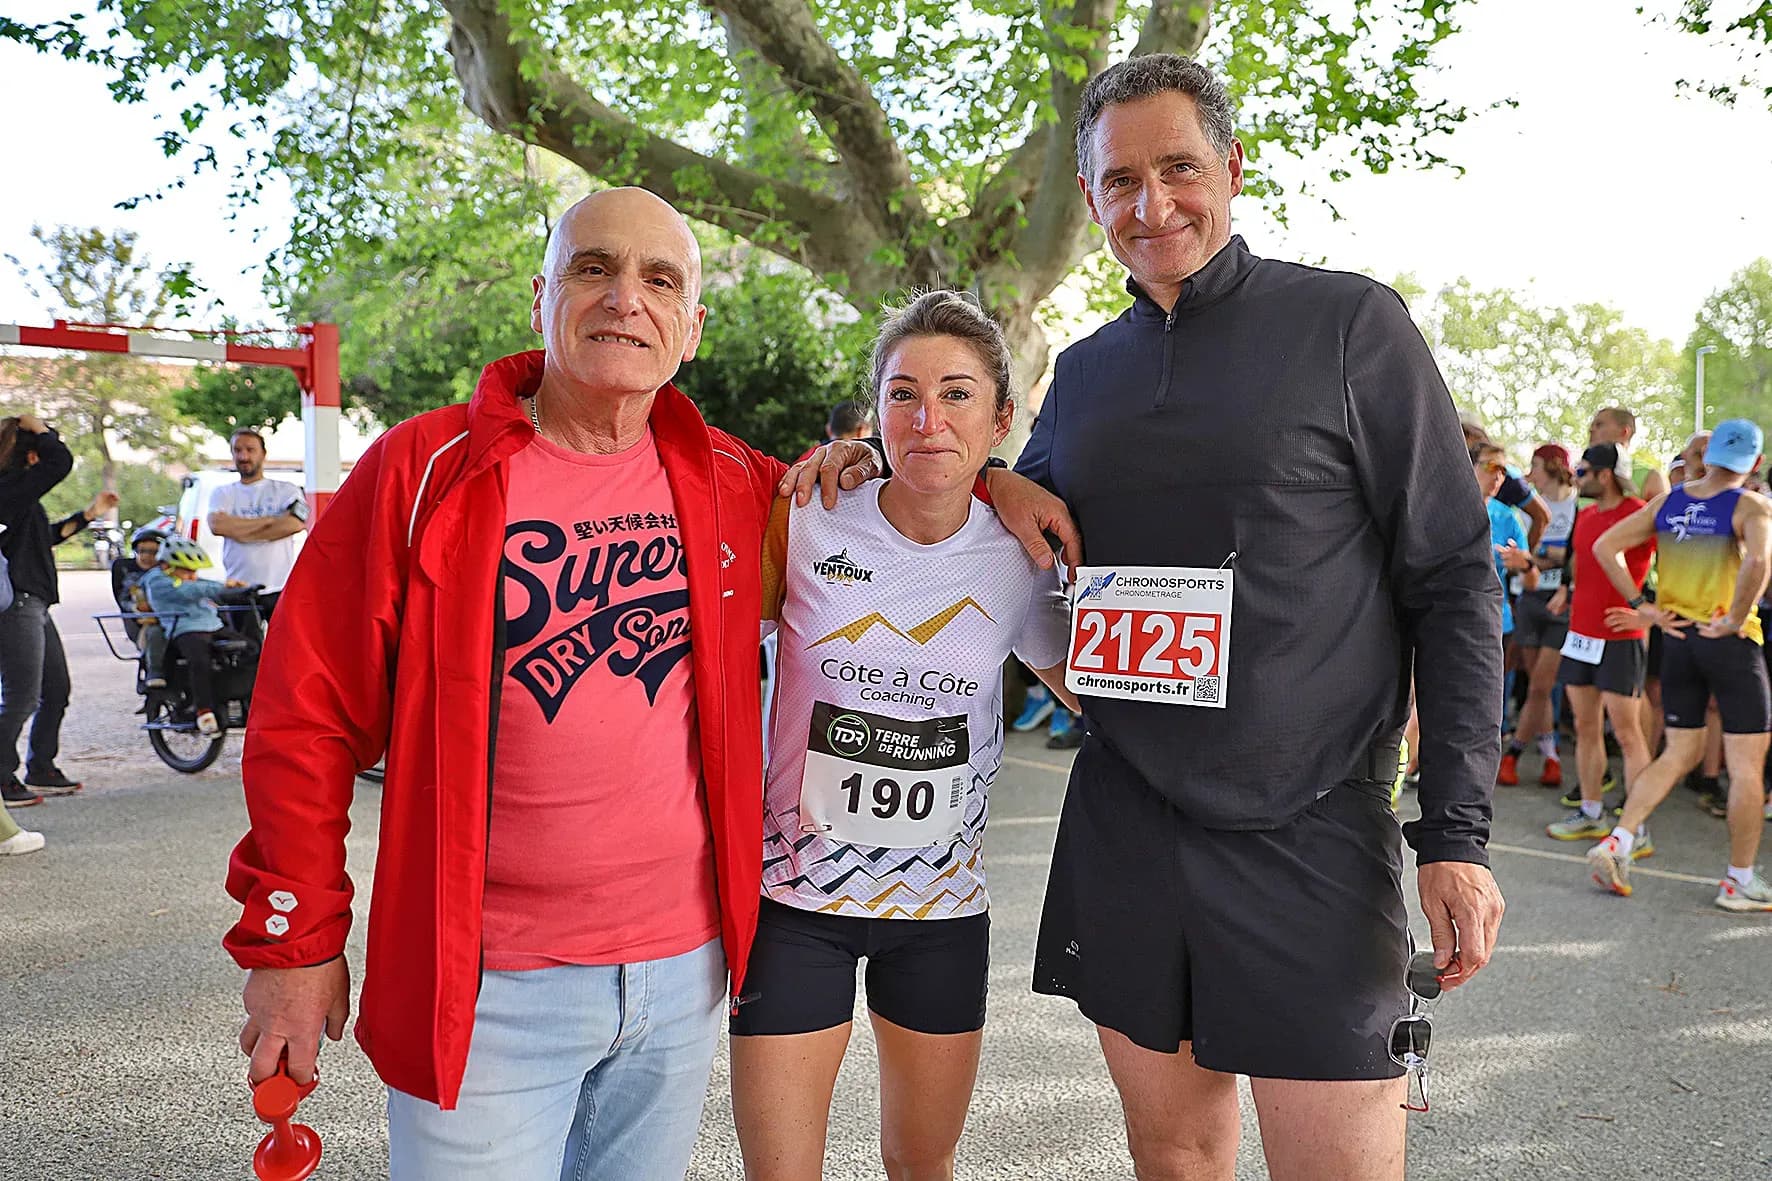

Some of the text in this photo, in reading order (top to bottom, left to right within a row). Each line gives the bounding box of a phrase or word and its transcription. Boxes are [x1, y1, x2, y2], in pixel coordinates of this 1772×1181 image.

[573, 512, 678, 541] 堅い天候会社
[813, 561, 873, 582] VENTOUX
[1115, 590, 1183, 598] CHRONOMETRAGE
[1116, 577, 1225, 590] CHRONOSPORTS
[1074, 611, 1216, 677] 2125
[525, 624, 596, 698] DRY
[820, 659, 979, 697] Côte à Côte
[1077, 674, 1190, 695] chronosports.fr
[860, 687, 936, 710] Coaching
[834, 726, 865, 746] TDR
[875, 728, 920, 748] TERRE
[840, 772, 935, 821] 190
